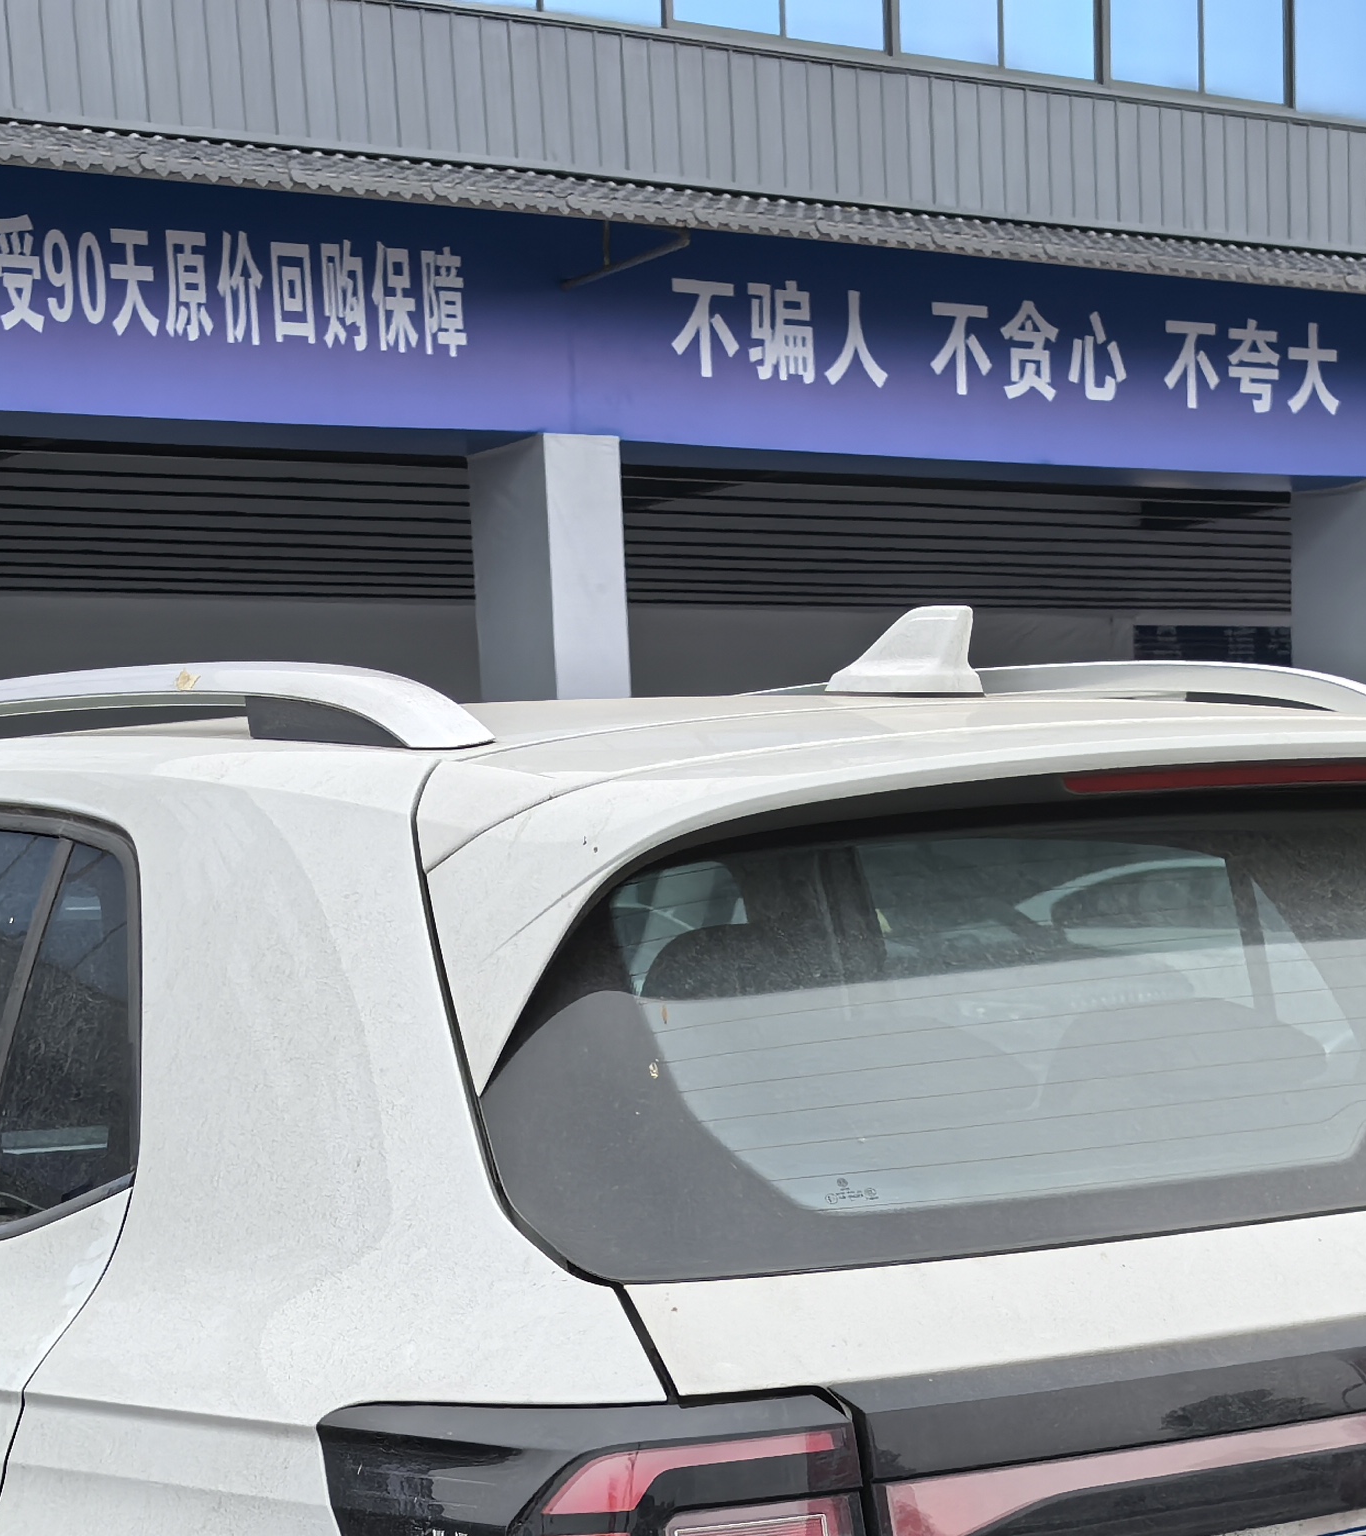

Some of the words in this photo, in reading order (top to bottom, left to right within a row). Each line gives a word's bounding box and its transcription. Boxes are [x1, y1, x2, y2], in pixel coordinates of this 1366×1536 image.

[671, 277, 889, 389] 不骗人
[929, 299, 1128, 402] 不贪心
[1163, 318, 1341, 416] 不夸大
